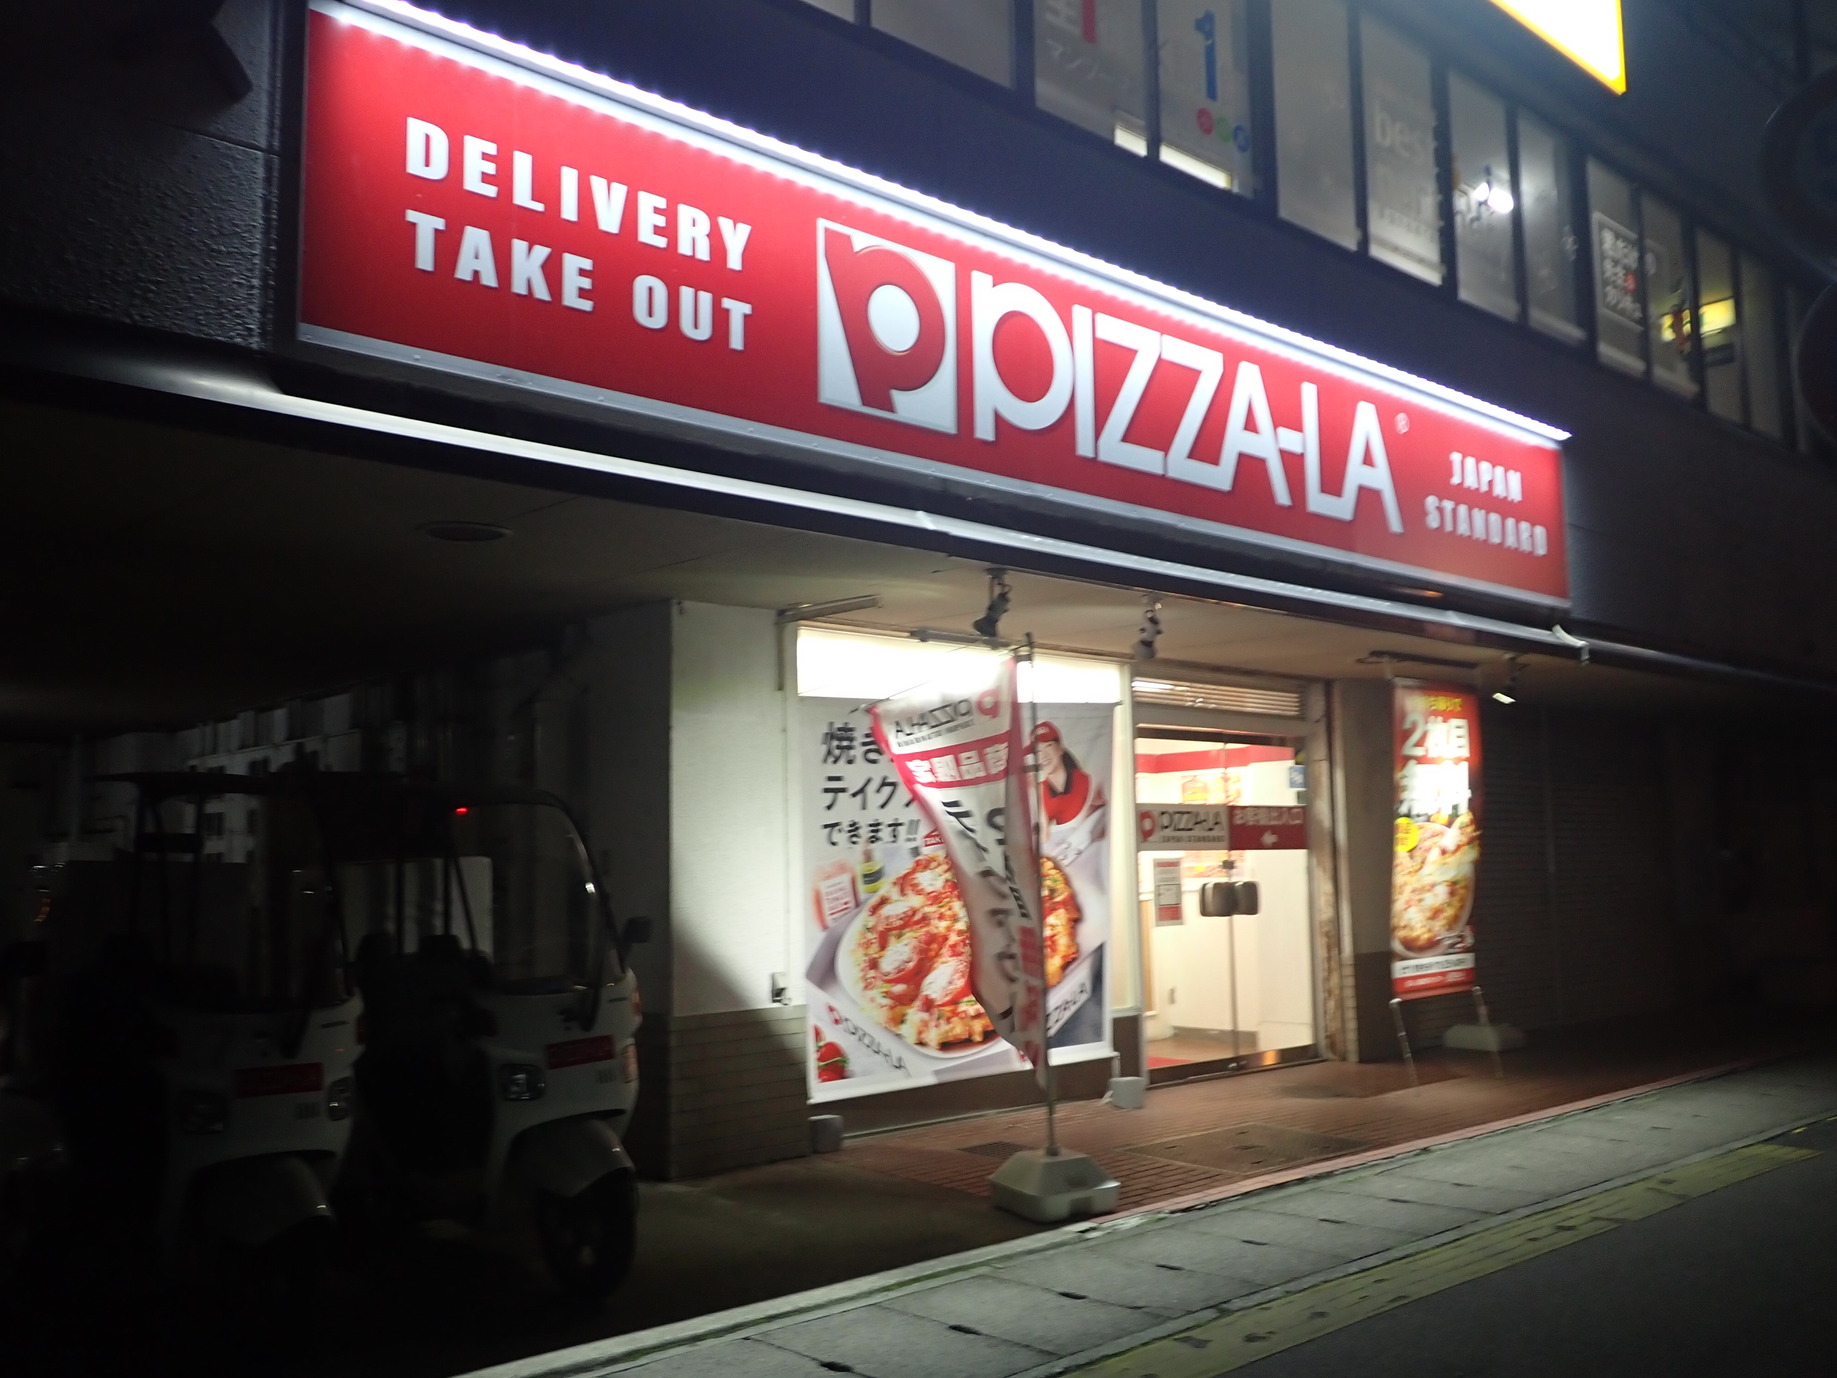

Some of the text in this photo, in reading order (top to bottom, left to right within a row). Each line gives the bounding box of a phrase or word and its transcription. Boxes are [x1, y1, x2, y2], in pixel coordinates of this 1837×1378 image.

[405, 117, 751, 271] DELIVERY
[405, 209, 752, 351] TAKE OUT
[1449, 451, 1523, 503] JAPAN
[1424, 495, 1548, 557] STANDARD
[821, 721, 892, 765] 焼き
[821, 775, 914, 812] テイク
